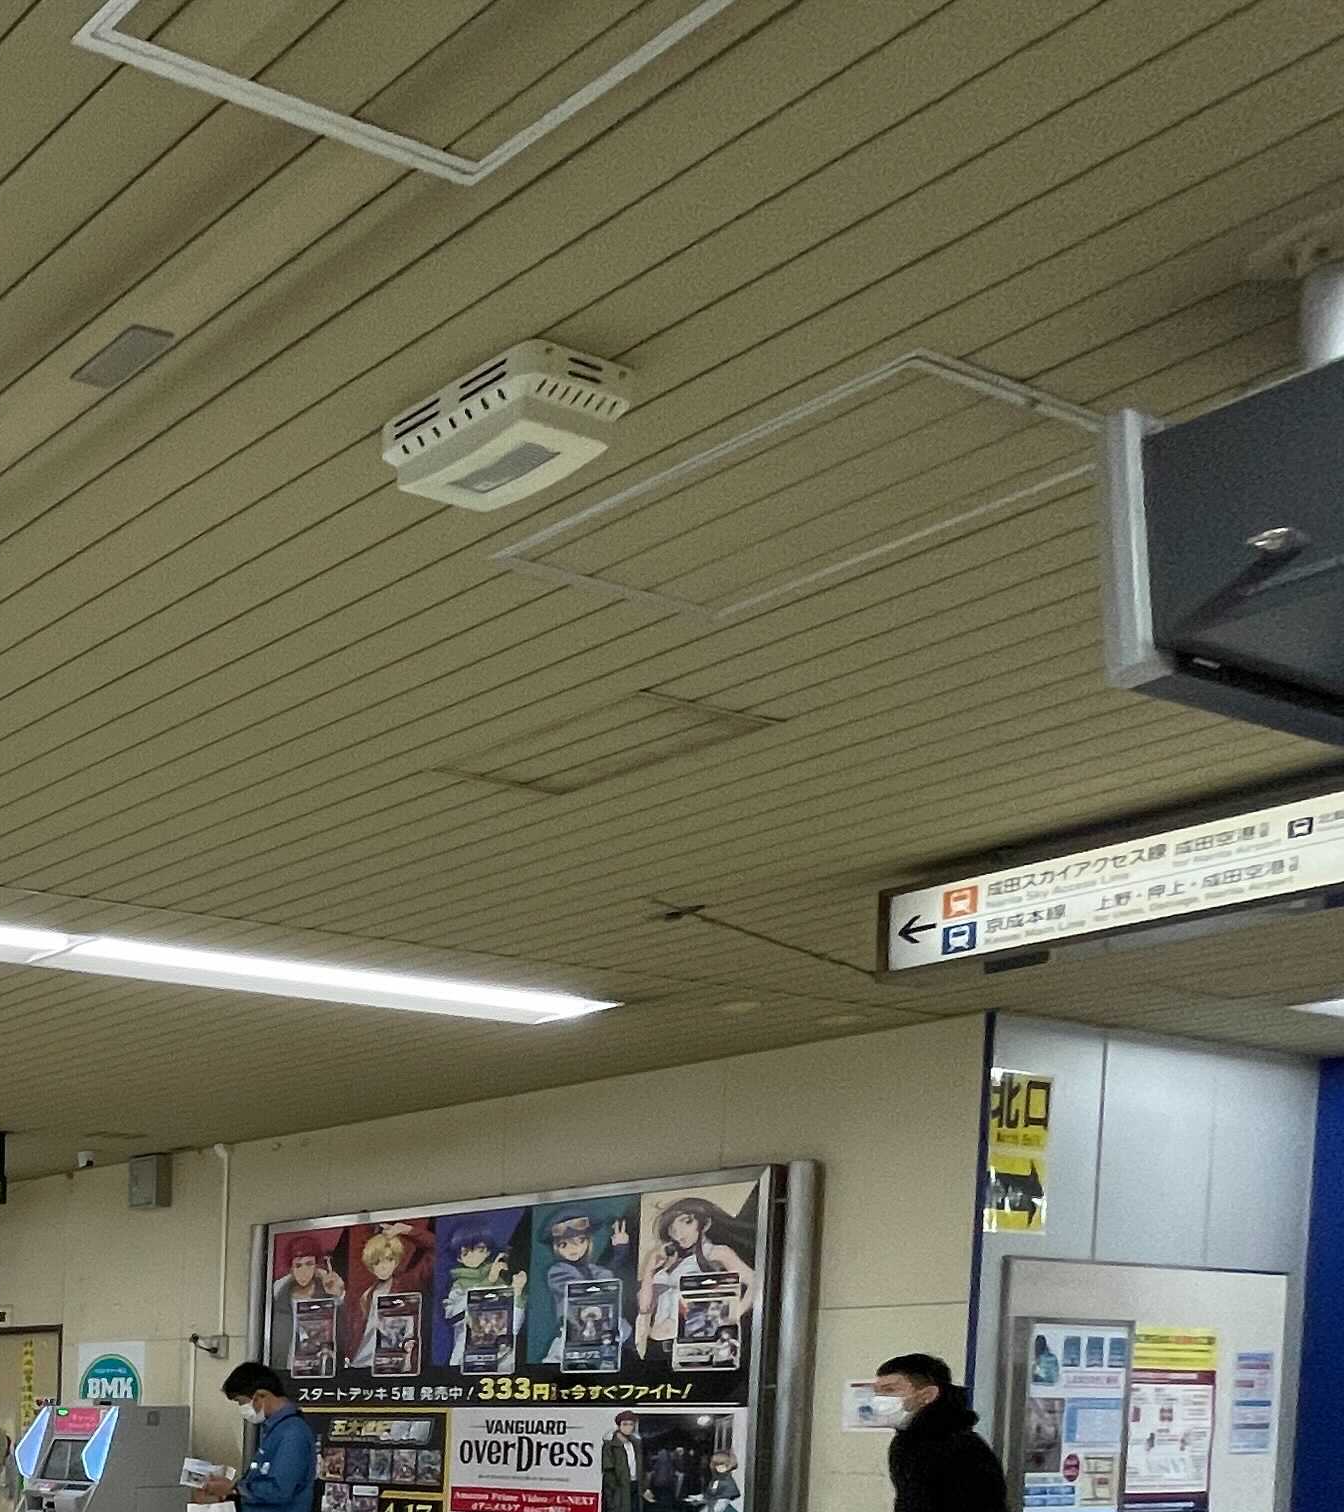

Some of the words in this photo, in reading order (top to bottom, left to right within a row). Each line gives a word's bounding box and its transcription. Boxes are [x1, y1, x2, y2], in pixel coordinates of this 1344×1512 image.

[987, 843, 1167, 897] 成田スカイアクセス線
[986, 904, 1066, 934] 京成本線
[87, 1376, 134, 1399] BMK
[485, 1419, 567, 1435] VANGUARD
[459, 1436, 594, 1472] overDress
